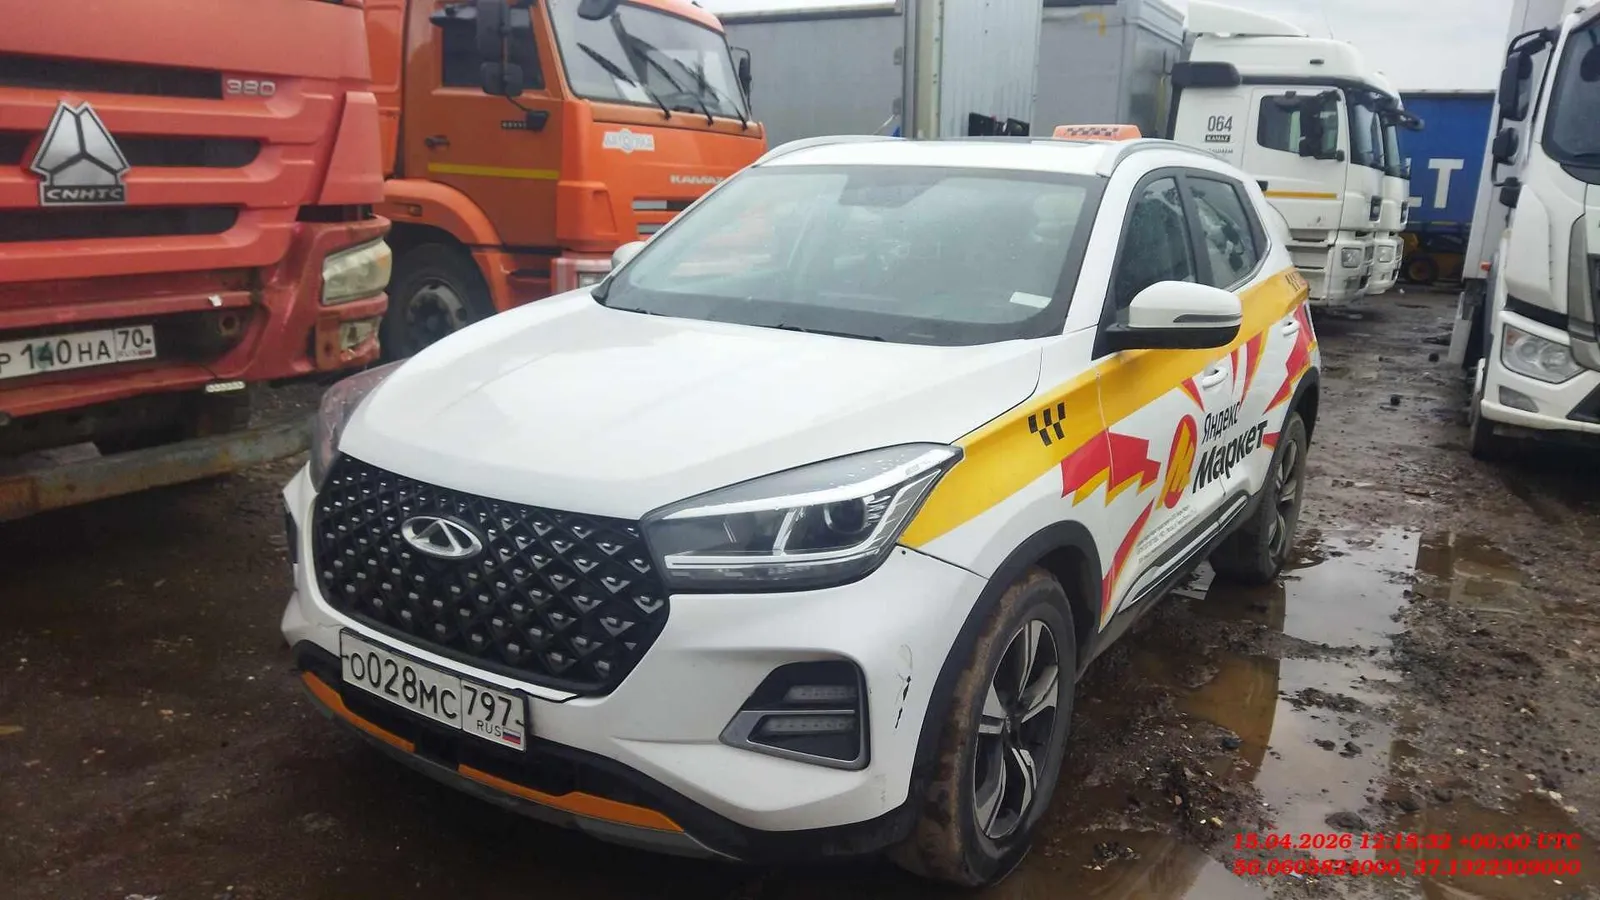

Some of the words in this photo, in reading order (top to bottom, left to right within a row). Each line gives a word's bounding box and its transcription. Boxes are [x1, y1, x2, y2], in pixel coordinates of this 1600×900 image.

[226, 78, 276, 96] 380
[1207, 115, 1233, 132] 064
[46, 188, 123, 201] CNHTC
[117, 329, 145, 350] 70
[1201, 401, 1241, 445] Яндекс
[1192, 420, 1268, 494] Маркет
[463, 685, 512, 727] 797
[476, 719, 502, 737] RUS
